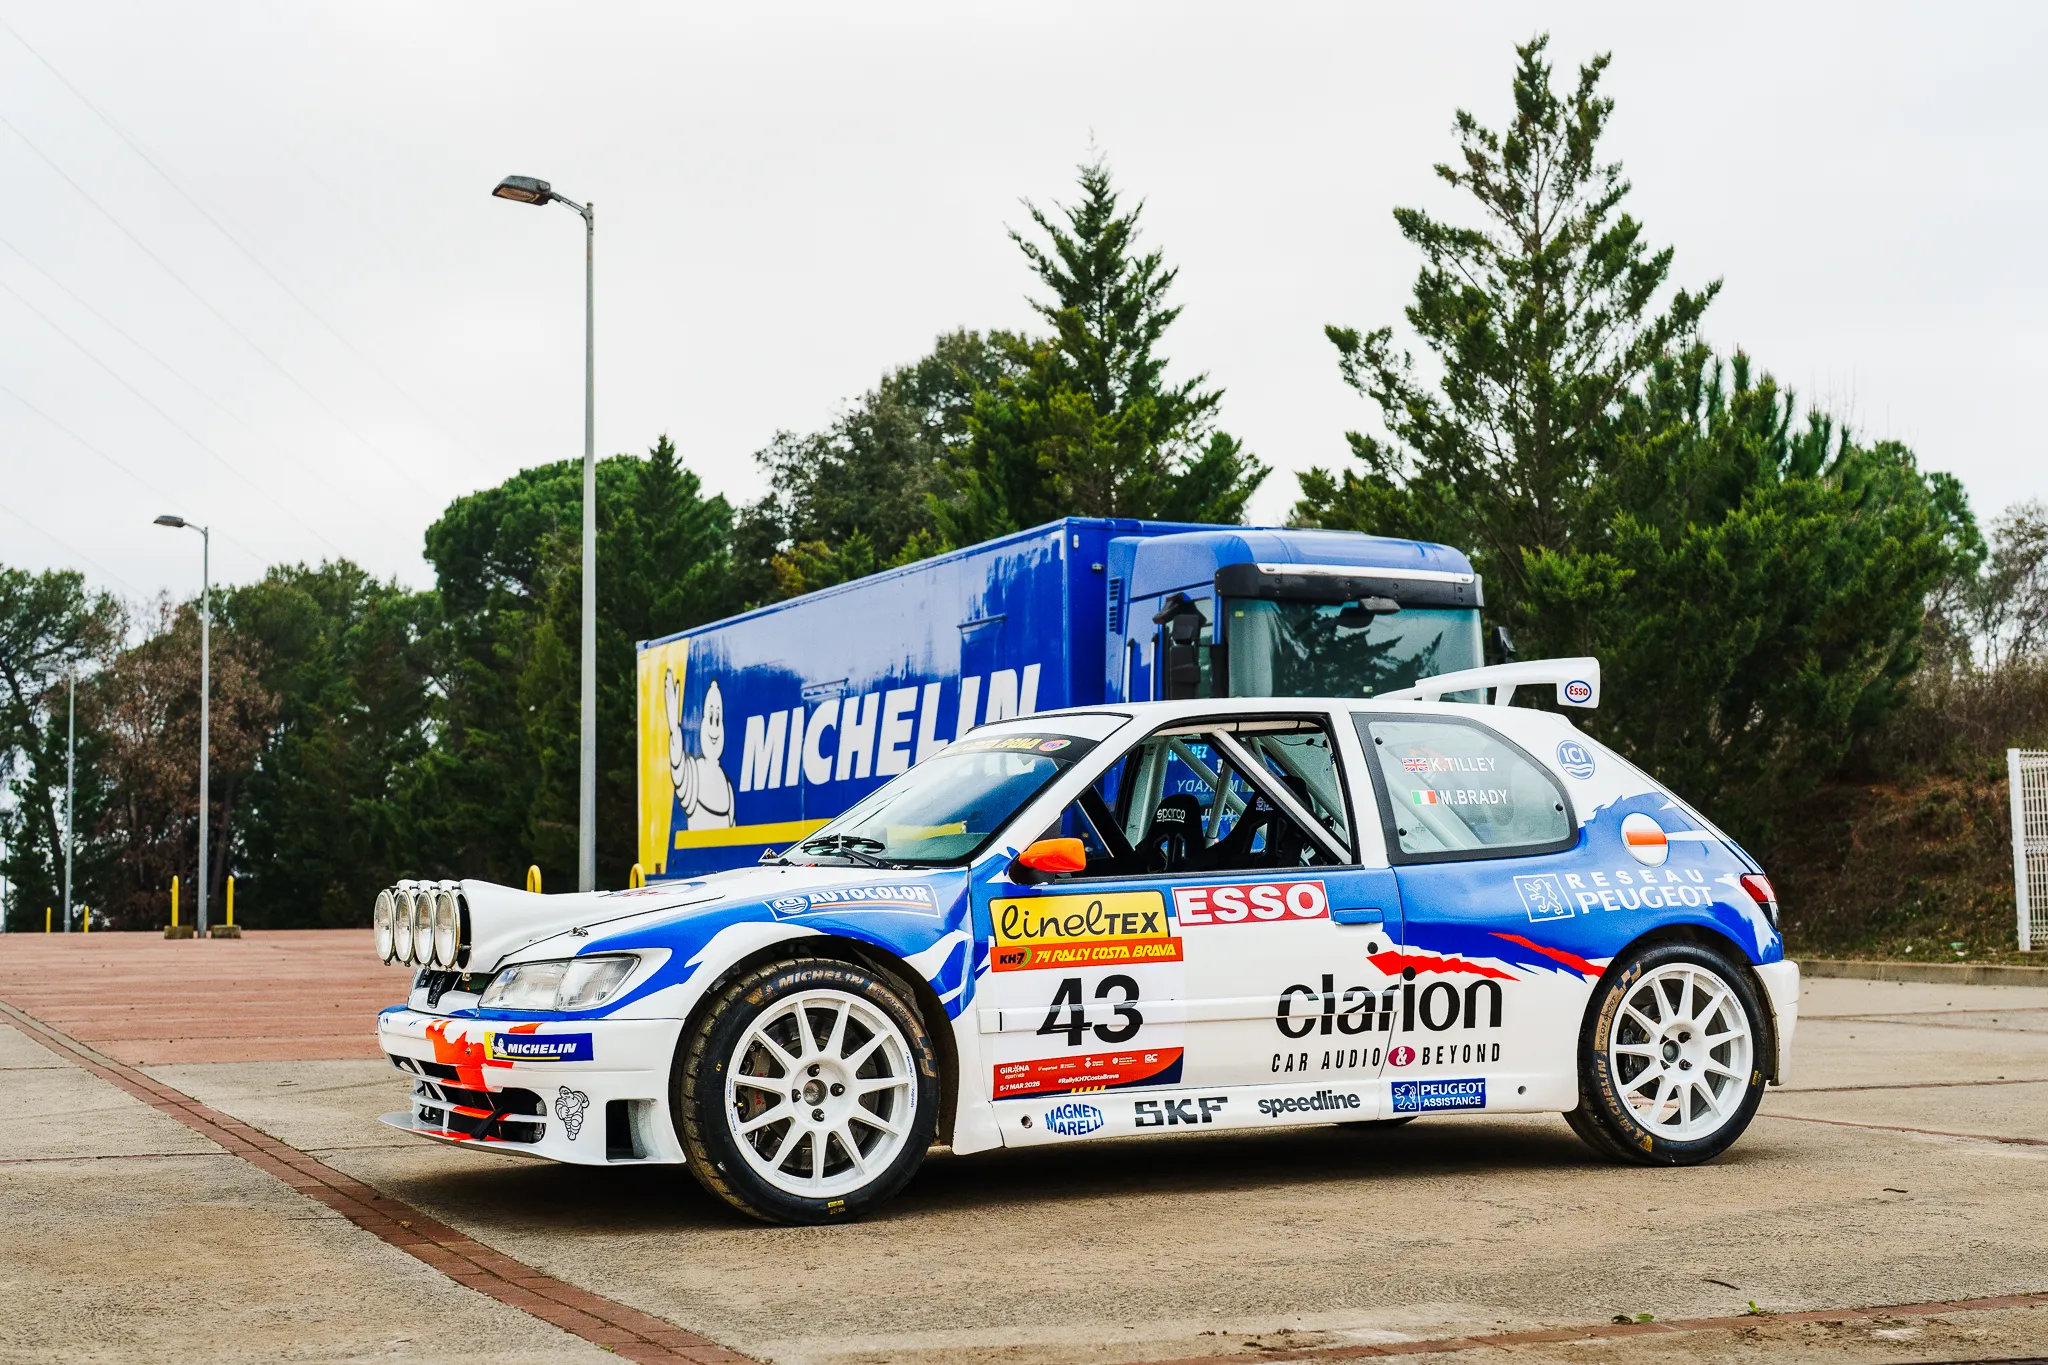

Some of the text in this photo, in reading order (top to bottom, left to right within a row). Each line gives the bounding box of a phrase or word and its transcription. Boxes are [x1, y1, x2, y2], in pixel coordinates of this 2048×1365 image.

[739, 663, 1041, 792] MICHELIN
[1429, 757, 1496, 772] K.TILLEY
[1561, 747, 1587, 763] ICI
[1440, 789, 1508, 805] M.BRADY
[1156, 807, 1186, 823] sparco
[1564, 869, 1705, 890] RESEAU
[779, 886, 932, 906] ICI AUTOCOLOR
[1178, 883, 1326, 924] ESSO
[1575, 885, 1715, 914] PEUGEOT
[1035, 950, 1052, 964] 74
[1051, 948, 1090, 963] RALLY
[1091, 946, 1130, 960] COSTA
[1132, 943, 1177, 958] BRAVA
[778, 970, 865, 989] MICHELIN
[1036, 974, 1144, 1047] 43
[1275, 966, 1504, 1039] clarion
[507, 1042, 577, 1055] MICHELIN
[1271, 1043, 1501, 1073] CAR AUDIO & BEYOND
[1010, 1082, 1024, 1090] MAR
[1421, 1081, 1485, 1096] PEUGEOT
[1135, 1096, 1228, 1127] SKF
[1257, 1089, 1361, 1118] speedline
[1423, 1096, 1481, 1108] ASSISTANCE
